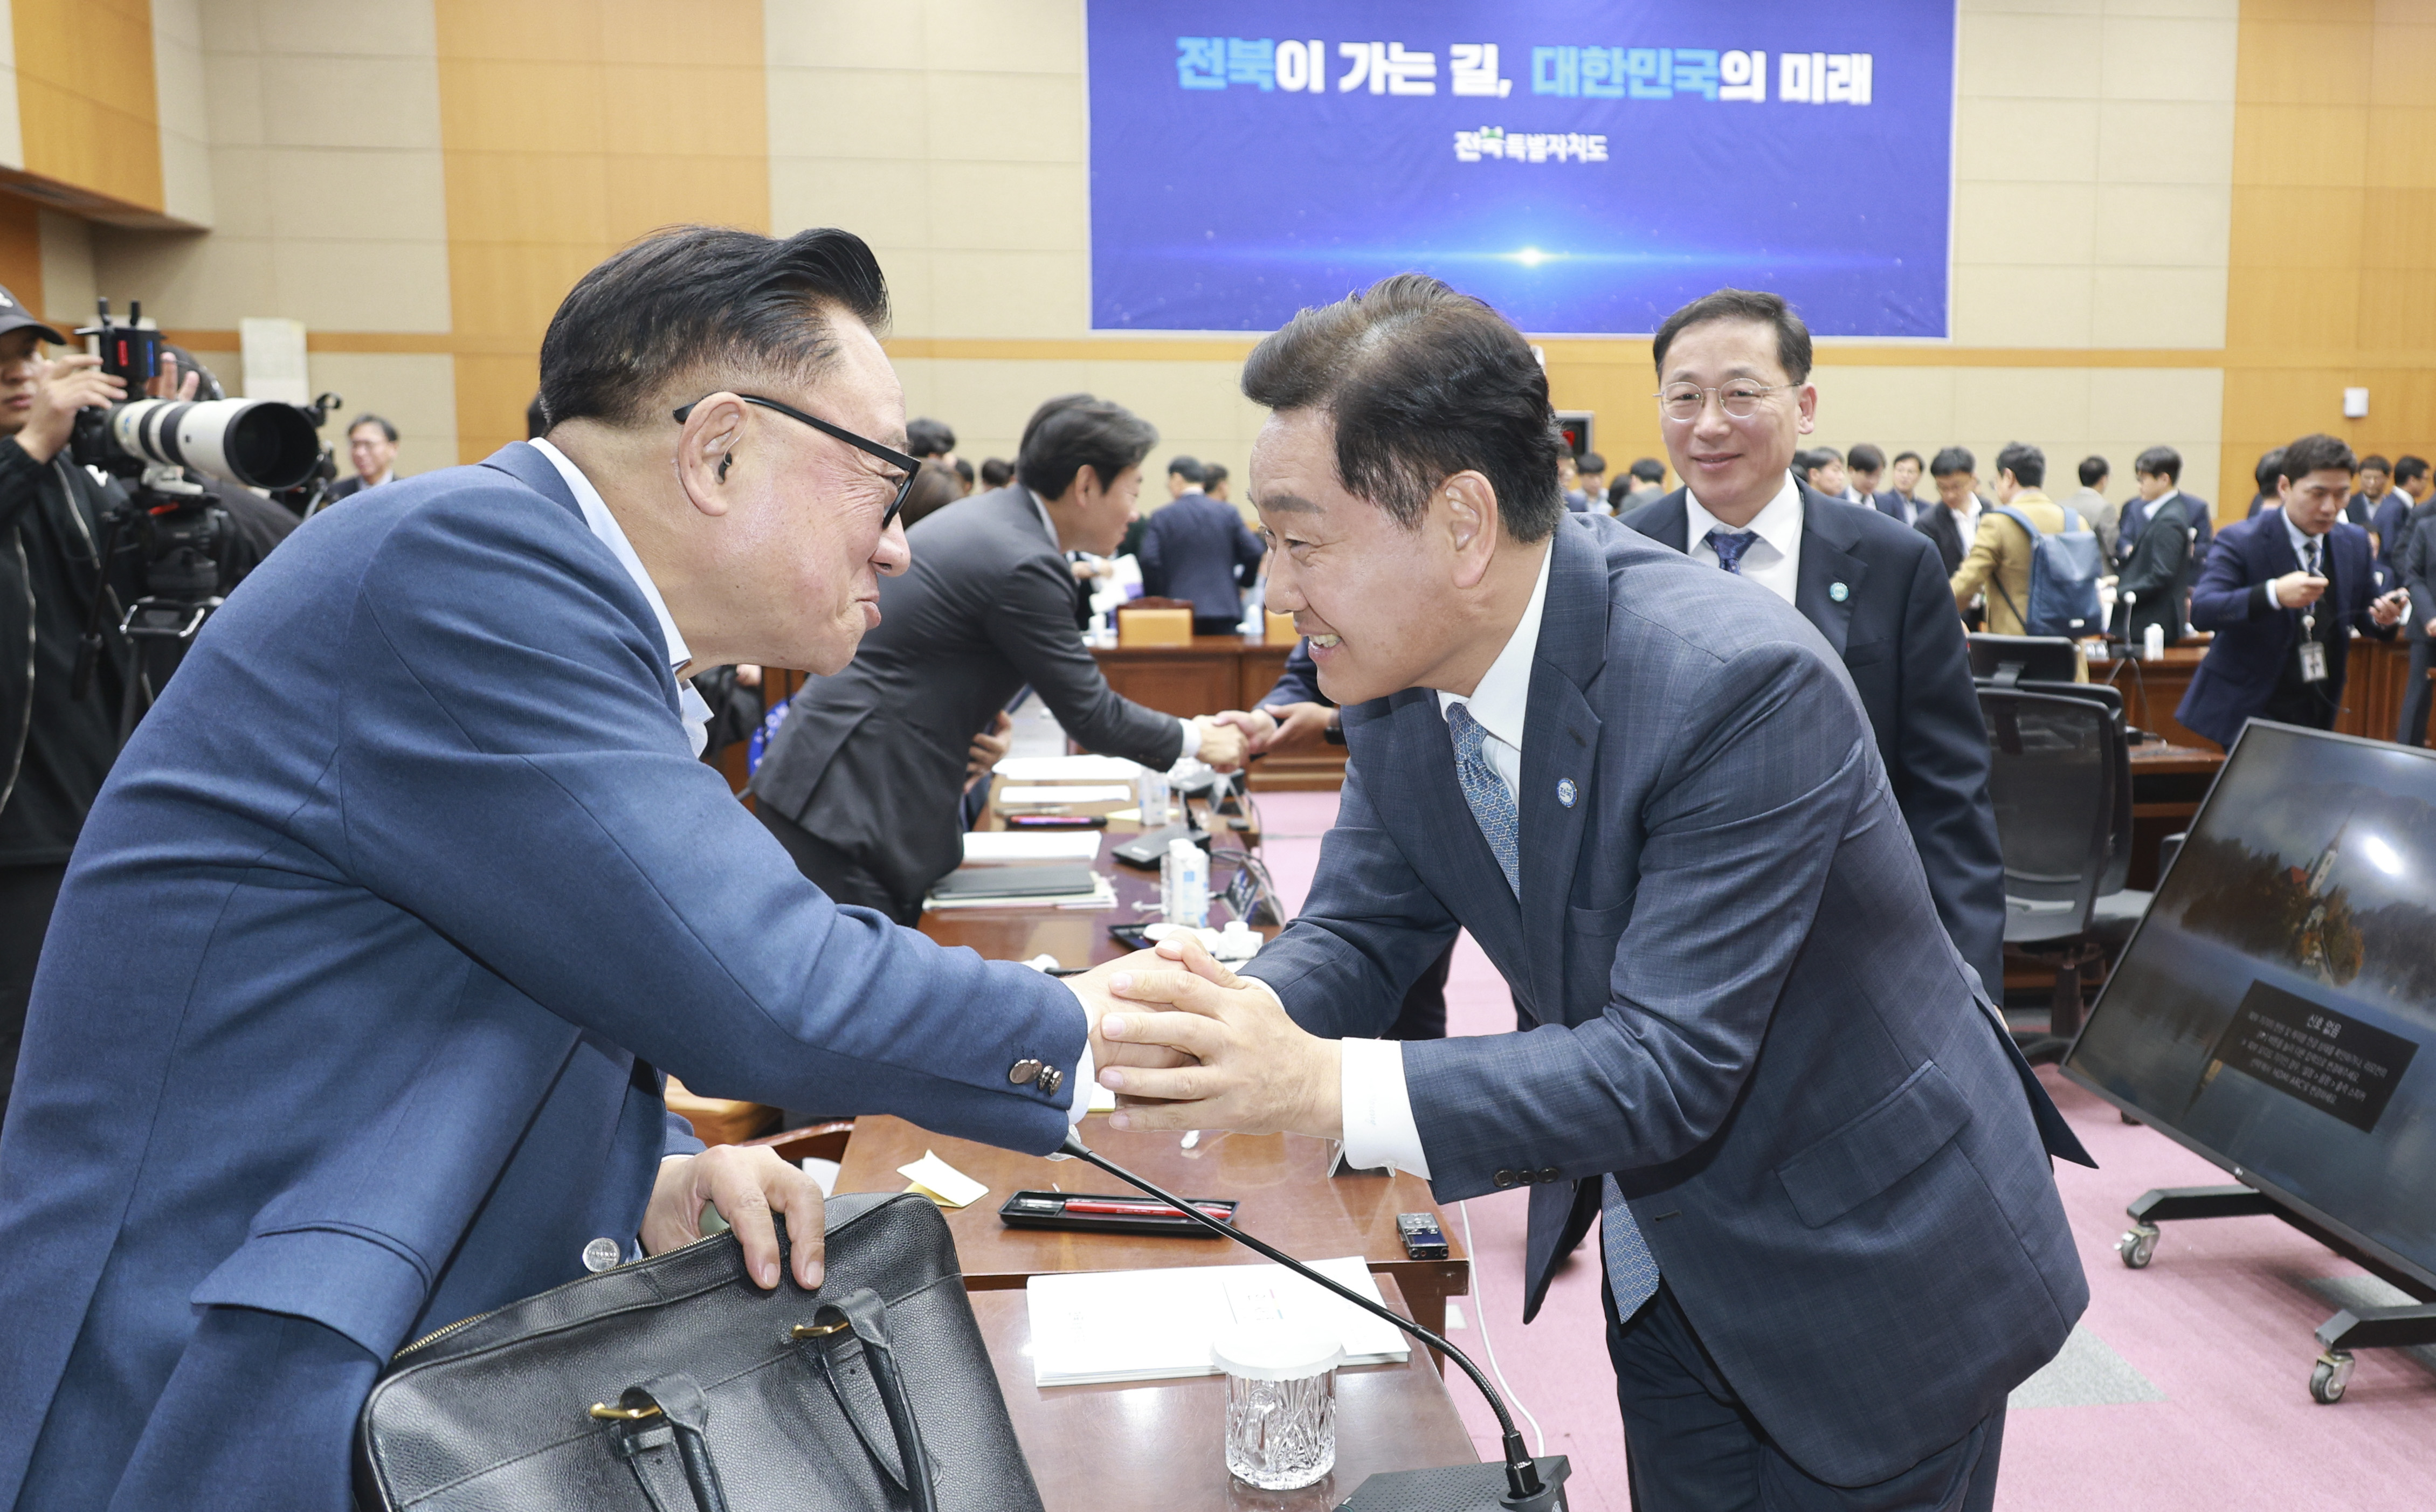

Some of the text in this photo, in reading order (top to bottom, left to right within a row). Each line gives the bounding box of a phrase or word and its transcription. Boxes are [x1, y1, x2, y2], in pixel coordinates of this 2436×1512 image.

[1176, 37, 1873, 105] 전북이 가는 길, 대한민국의 미래
